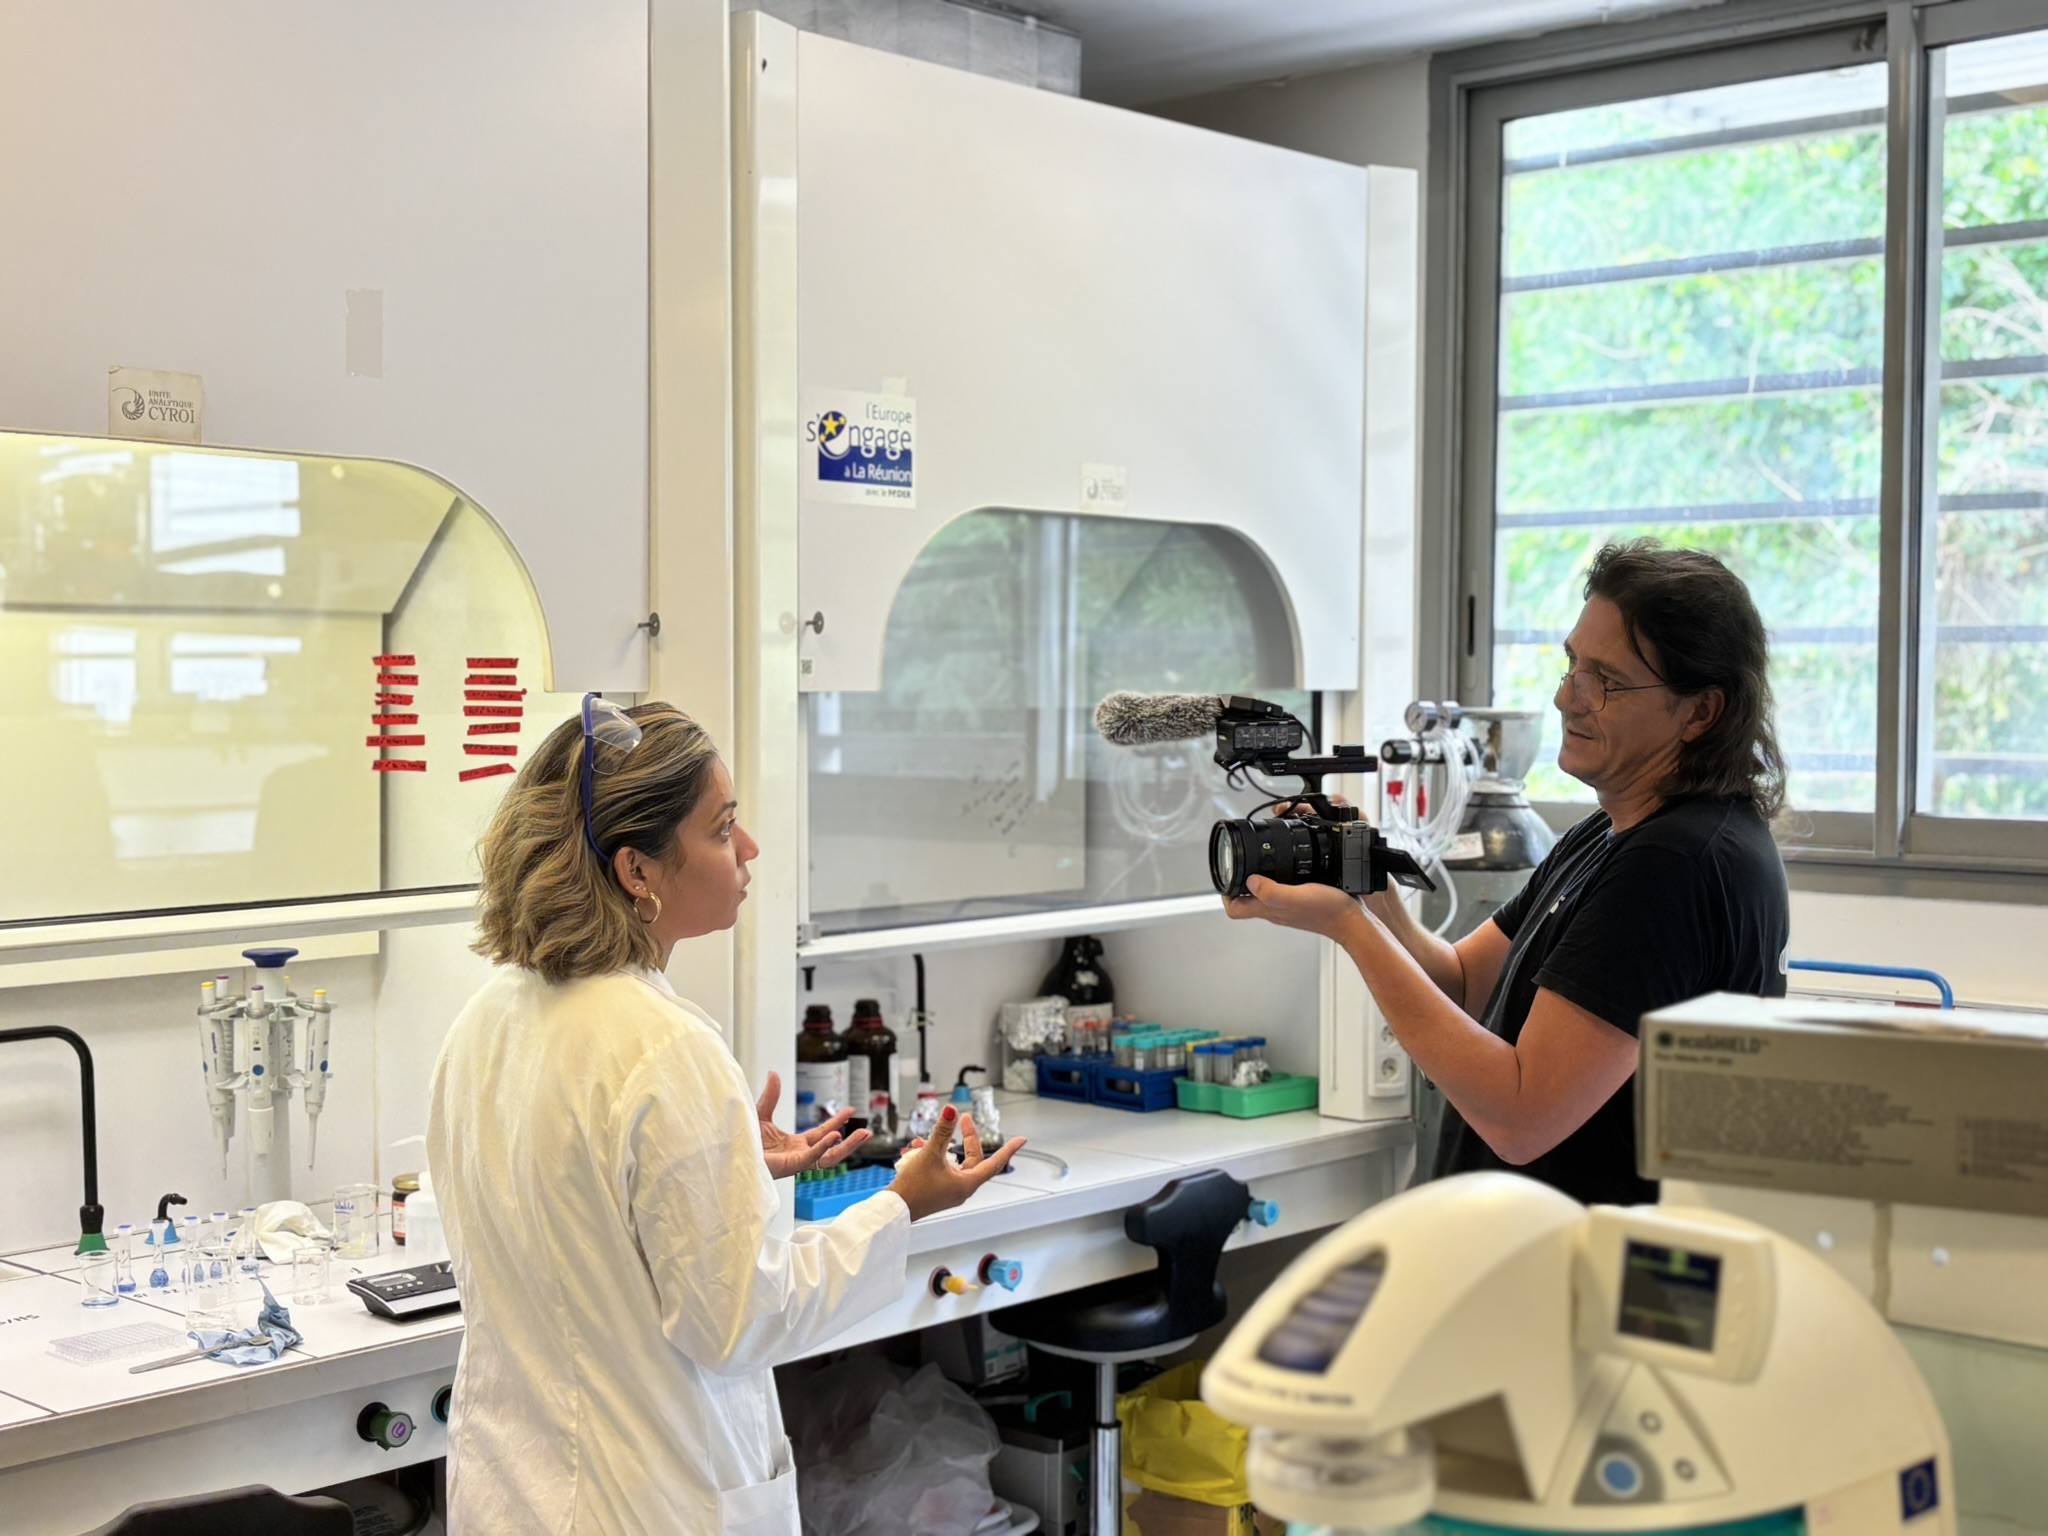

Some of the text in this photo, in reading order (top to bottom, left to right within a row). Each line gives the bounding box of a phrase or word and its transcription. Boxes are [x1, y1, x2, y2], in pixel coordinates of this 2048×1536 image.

[148, 398, 194, 409] ANALYTIQUE
[148, 406, 195, 424] CYROI
[852, 461, 866, 479] La
[867, 463, 912, 483] Réunion
